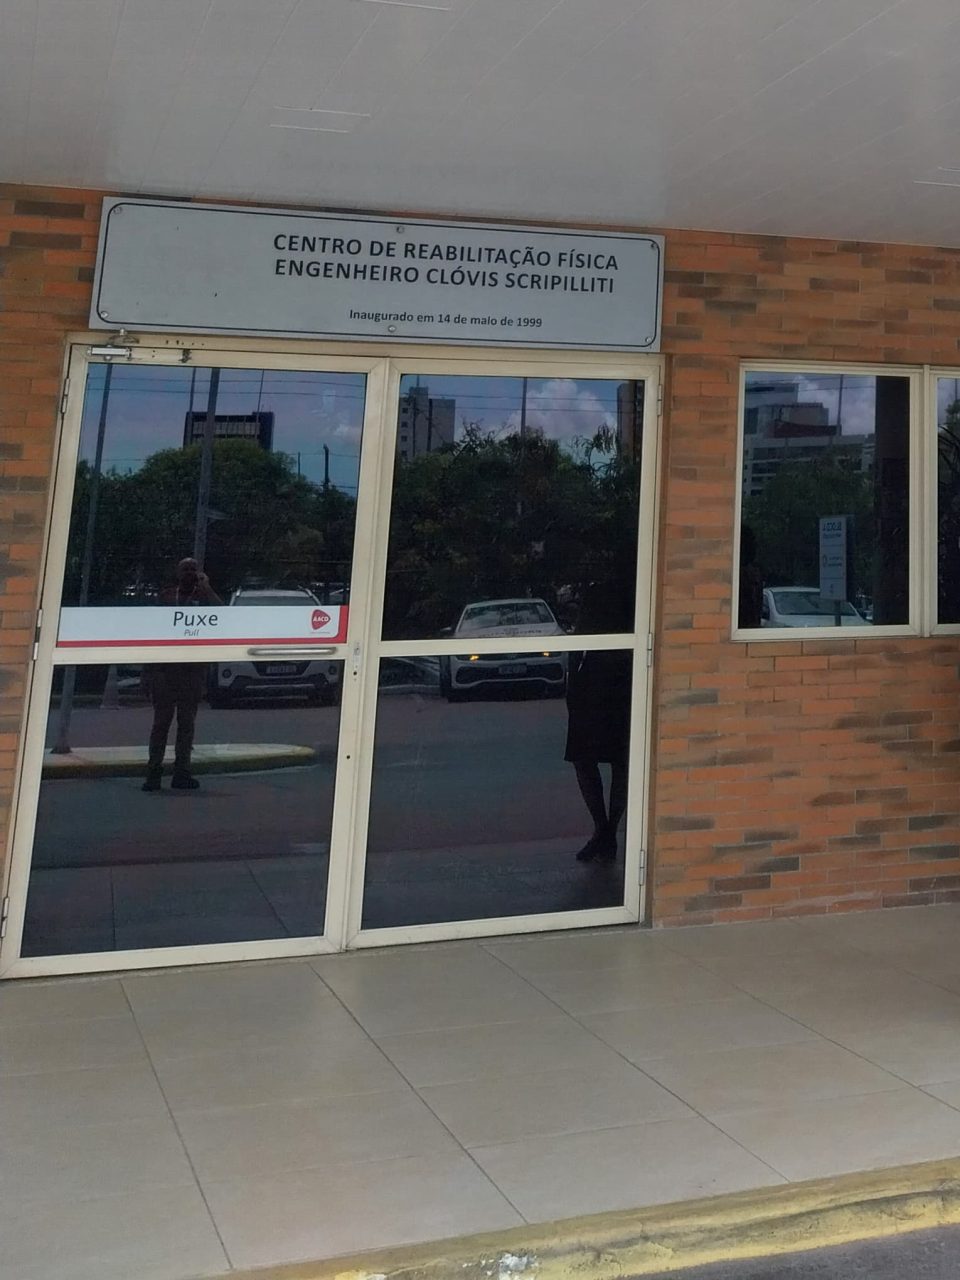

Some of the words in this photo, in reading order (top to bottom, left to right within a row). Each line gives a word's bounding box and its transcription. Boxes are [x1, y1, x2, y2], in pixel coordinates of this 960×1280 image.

[274, 234, 362, 256] CENTRO
[369, 240, 396, 258] DE
[404, 242, 551, 269] REABILITAÇÃO
[558, 248, 619, 271] FÍSICA
[275, 259, 419, 283] ENGENHEIRO
[426, 266, 499, 288] CLÓVIS
[505, 272, 614, 294] SCRIPILLITI
[349, 309, 414, 323] Inaugurado
[417, 314, 435, 323] em
[438, 314, 451, 324] 14
[454, 314, 468, 325] de
[470, 316, 498, 326] maio
[500, 316, 514, 327] de
[516, 316, 543, 328] 1999
[173, 611, 218, 626] Puxe
[184, 629, 200, 637] Pull
